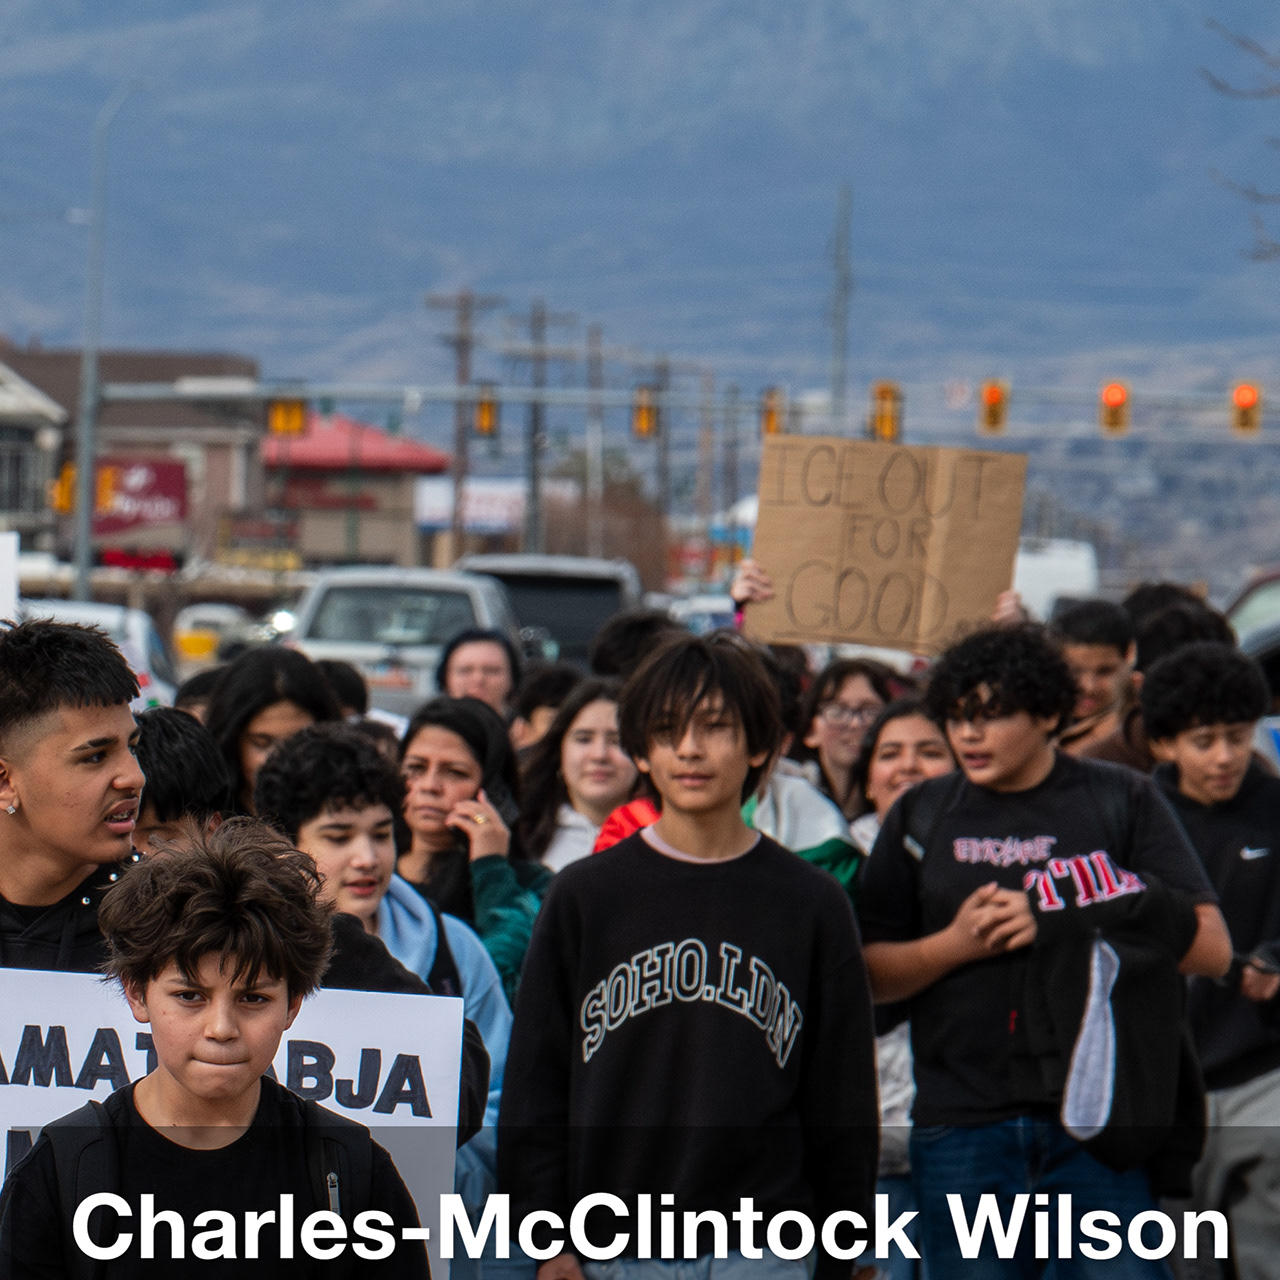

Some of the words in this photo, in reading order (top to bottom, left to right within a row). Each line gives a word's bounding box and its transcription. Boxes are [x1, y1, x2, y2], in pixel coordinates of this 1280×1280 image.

[761, 444, 871, 509] ICE
[877, 450, 1002, 520] OUT
[845, 512, 933, 560] FOR
[784, 558, 950, 638] GOOD
